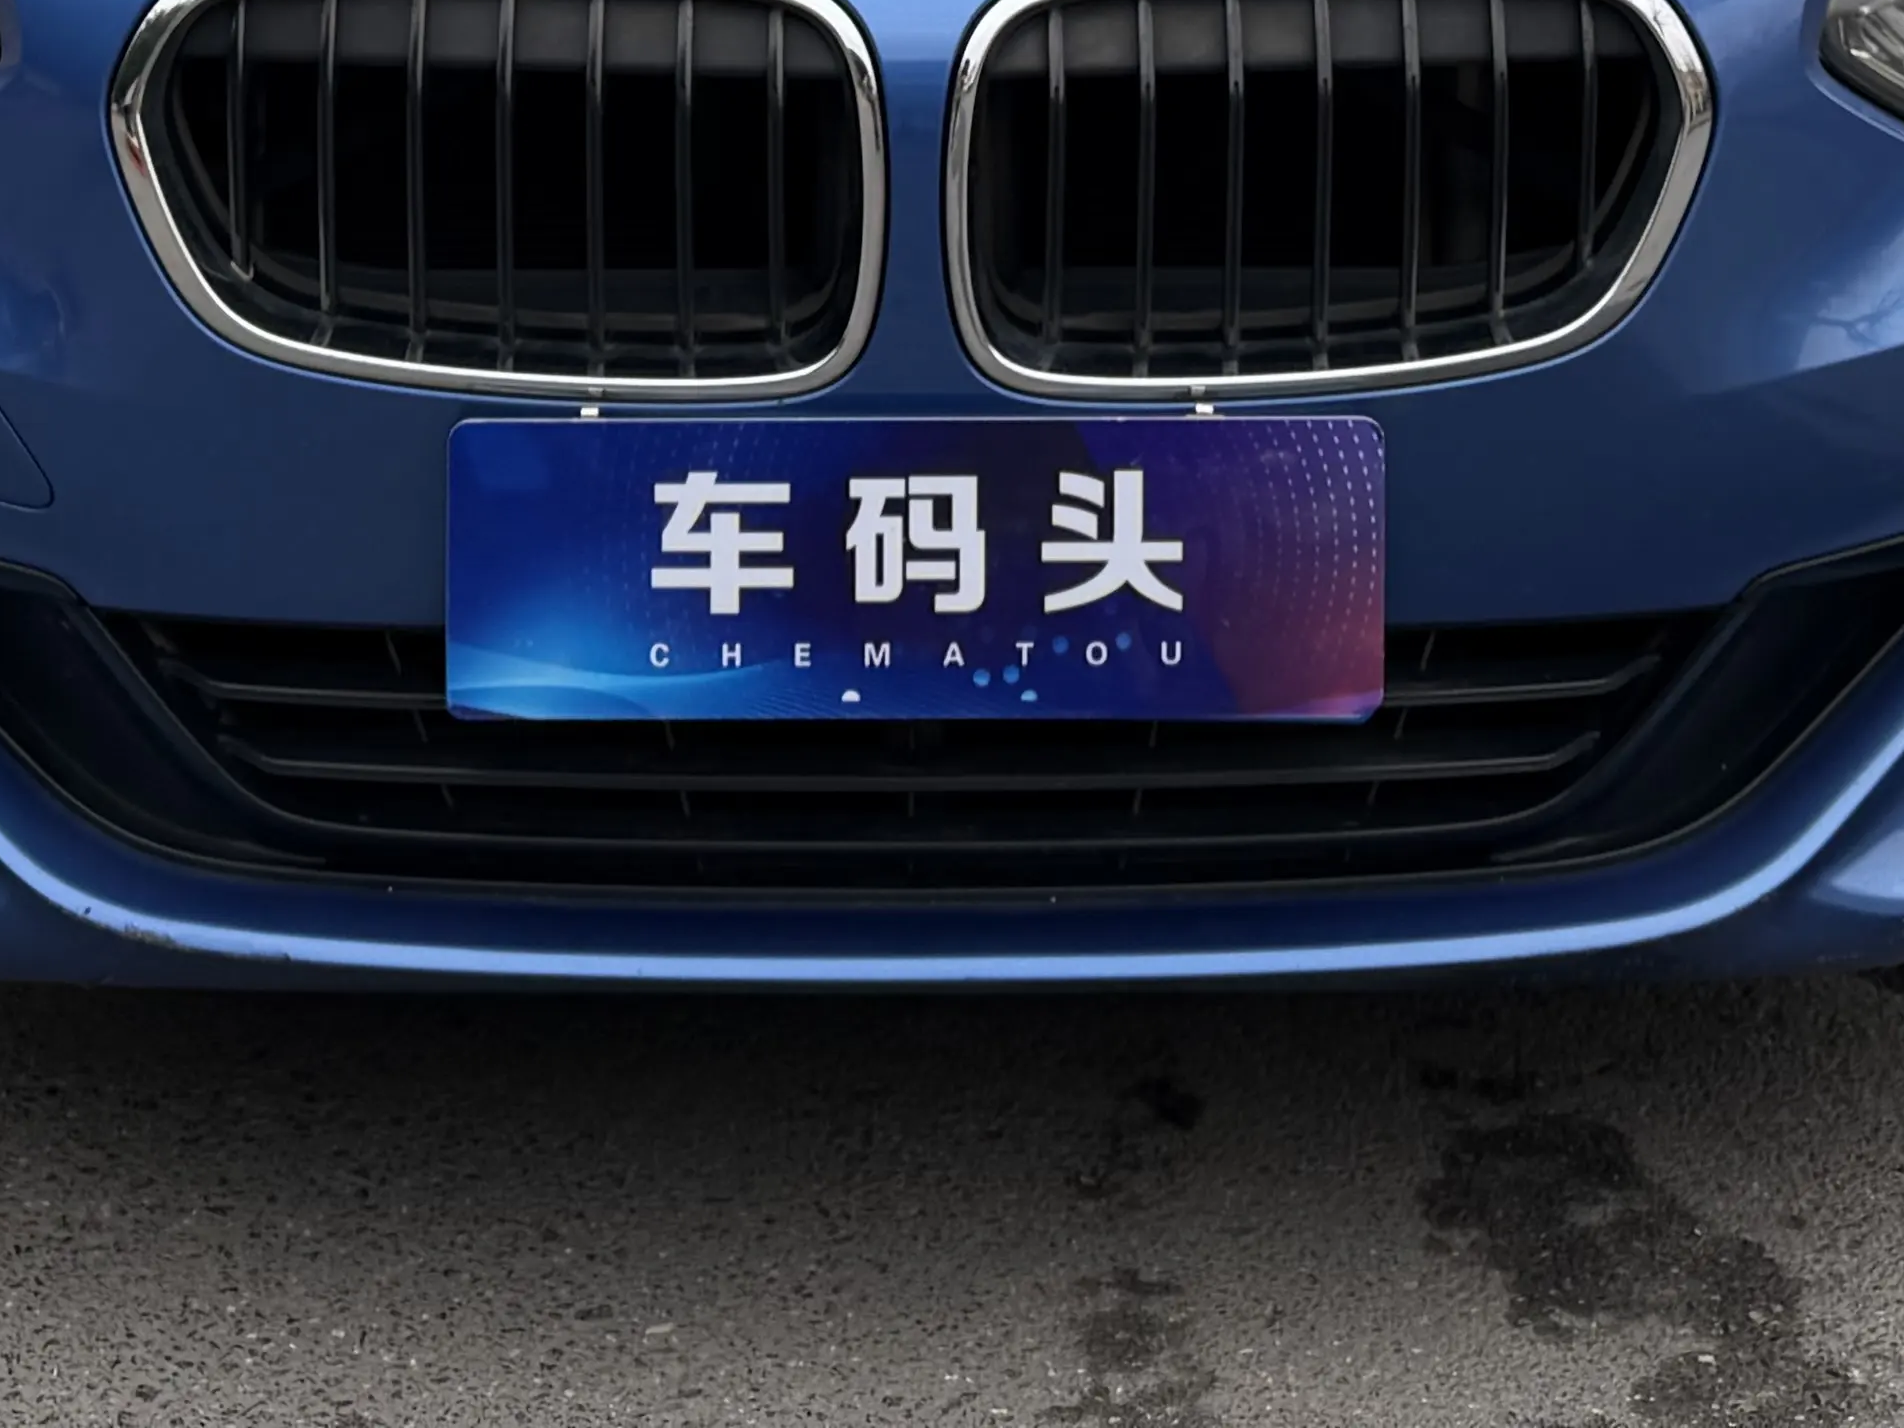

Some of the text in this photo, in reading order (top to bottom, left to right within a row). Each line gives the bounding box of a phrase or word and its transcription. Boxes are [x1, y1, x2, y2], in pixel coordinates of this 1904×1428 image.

[650, 470, 1185, 615] 车码头
[650, 640, 1183, 669] CHEMATOU
